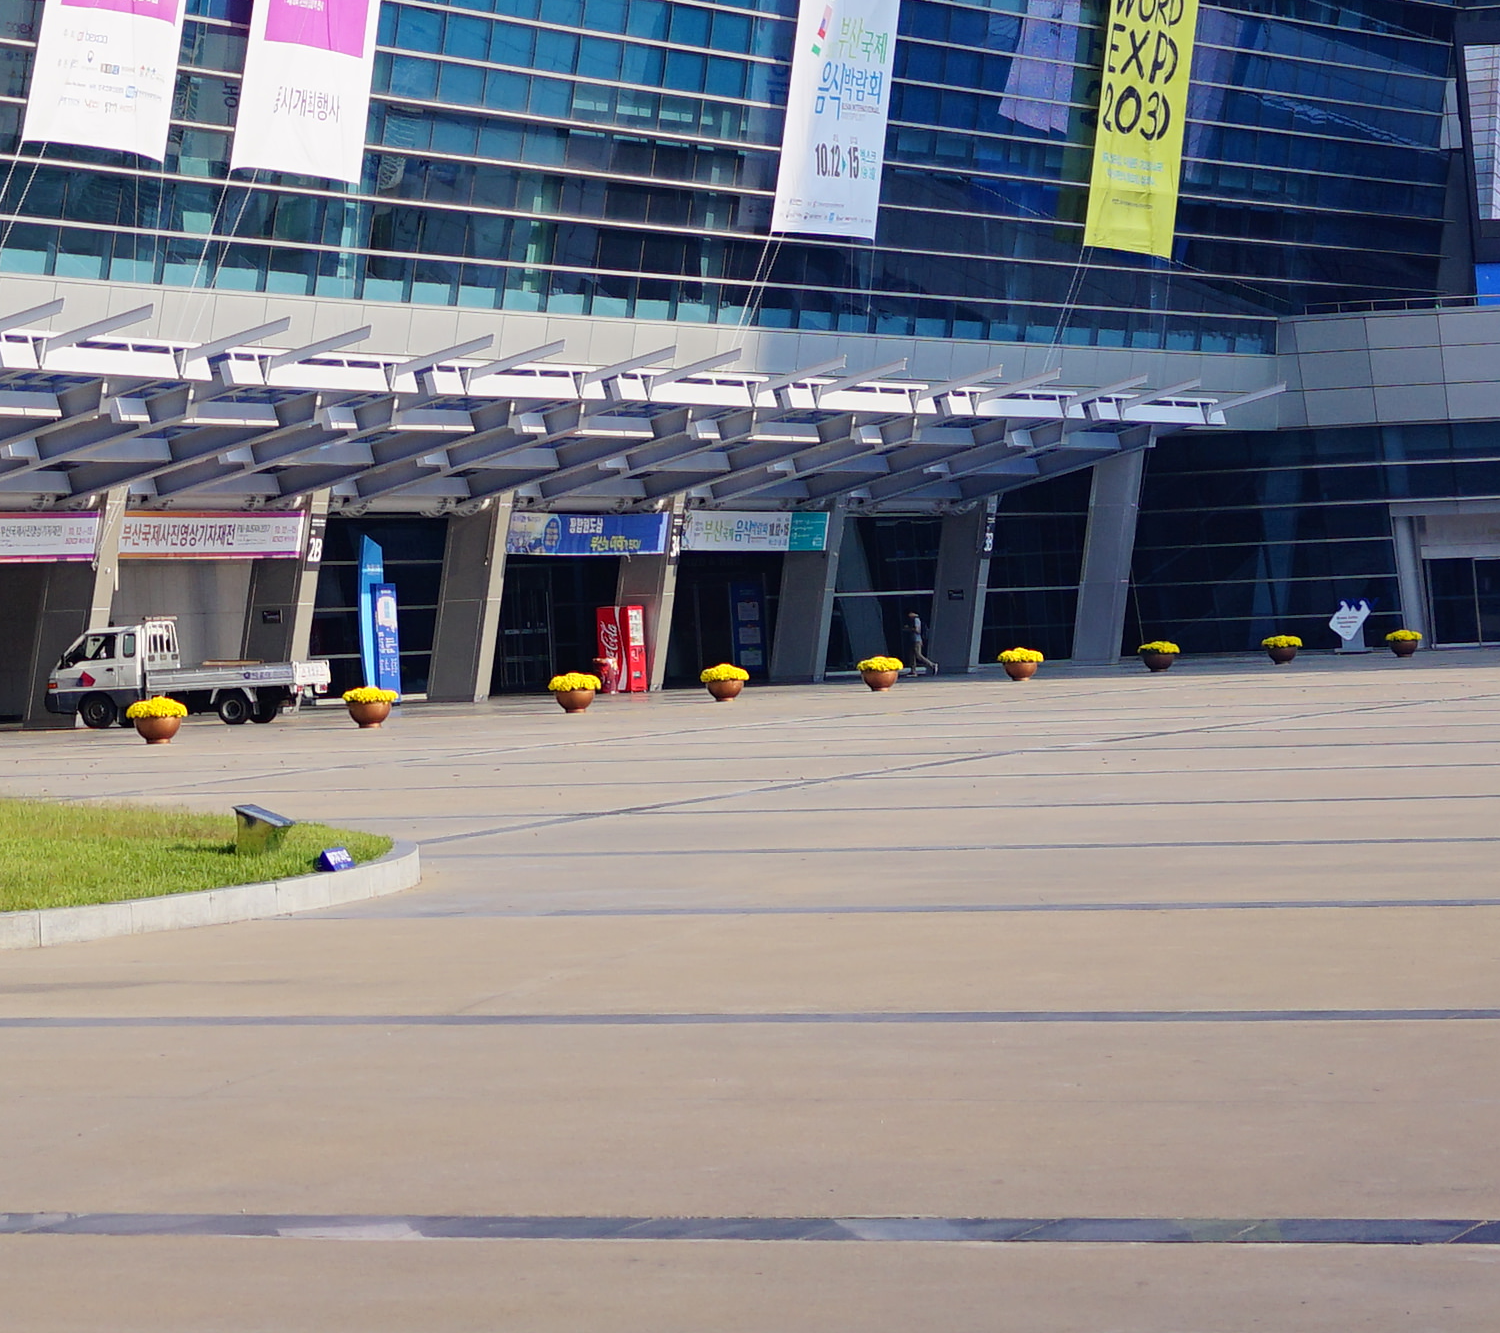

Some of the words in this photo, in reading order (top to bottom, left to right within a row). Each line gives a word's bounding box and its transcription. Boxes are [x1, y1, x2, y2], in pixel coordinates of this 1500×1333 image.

[838, 16, 889, 65] 부산국제
[814, 60, 884, 122] 음식박람회
[814, 142, 841, 179] 10.12
[847, 145, 860, 180] 15
[121, 522, 235, 547] 부산국제사진영상기자재전
[307, 537, 323, 563] 2B
